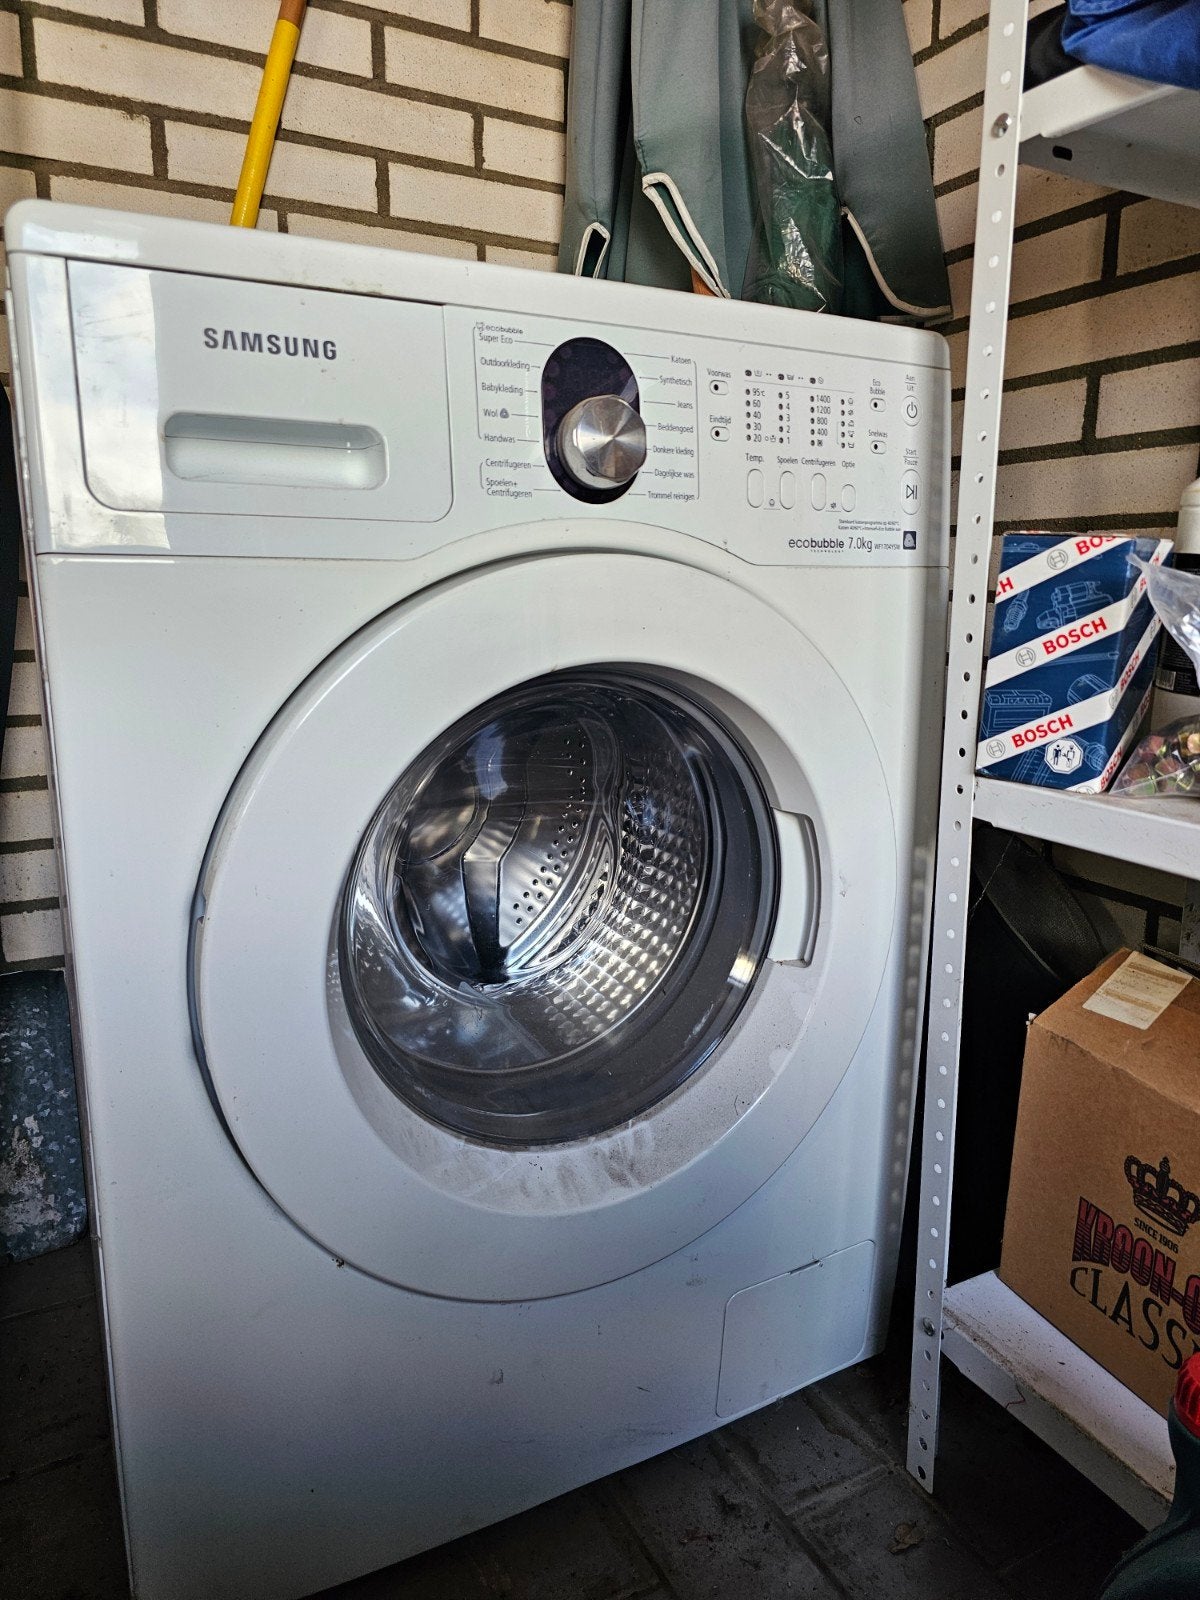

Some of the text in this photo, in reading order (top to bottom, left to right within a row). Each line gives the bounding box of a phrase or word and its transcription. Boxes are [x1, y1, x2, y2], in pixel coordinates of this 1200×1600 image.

[479, 332, 513, 344] Super Eco
[203, 327, 337, 361] SAMSUNG
[480, 356, 530, 371] Outdoorkleding
[671, 355, 692, 365] Katoen
[706, 368, 732, 378] Voorwas
[659, 375, 693, 386] Synthetisch
[872, 378, 881, 387] Eco
[481, 382, 524, 396] Babykleding
[869, 387, 886, 396] Bubble
[785, 391, 790, 400] 5
[816, 394, 831, 403] 1400
[677, 401, 693, 409] Jeans
[752, 400, 761, 408] 60
[483, 408, 498, 418] Wol
[816, 406, 831, 414] 1200
[709, 415, 731, 426] Eindtijd
[752, 411, 762, 420] 40
[786, 414, 791, 422] 3
[816, 417, 828, 425] 800
[657, 422, 694, 434] Beddengoed
[753, 422, 762, 431] 30
[786, 425, 791, 433] 2
[816, 428, 828, 437] 400
[868, 429, 888, 438] Snelwas
[484, 433, 516, 444] Handwas
[753, 434, 762, 443] 20
[652, 446, 694, 457] Donkere kleding
[905, 448, 917, 456] Start
[745, 453, 764, 464] Temp.
[777, 455, 798, 465] Spoelen
[801, 457, 836, 468] Centrifugeren
[904, 458, 918, 466] Pauze
[485, 458, 532, 470] Centrifugeren
[841, 460, 856, 469] Optie
[654, 468, 682, 480] Dagelijkse
[486, 478, 518, 490] Spoelen+
[486, 487, 533, 500] Centrifugeren
[648, 490, 695, 502] Trommel reinigen
[788, 537, 845, 549] ecobubble
[848, 536, 873, 553] 7.0kg
[996, 576, 1014, 598] H
[1042, 617, 1108, 655] BOSCH
[1011, 714, 1074, 748] BOSCH
[1133, 1216, 1179, 1254] SINCE 1906
[1069, 1266, 1200, 1370] CLASS
